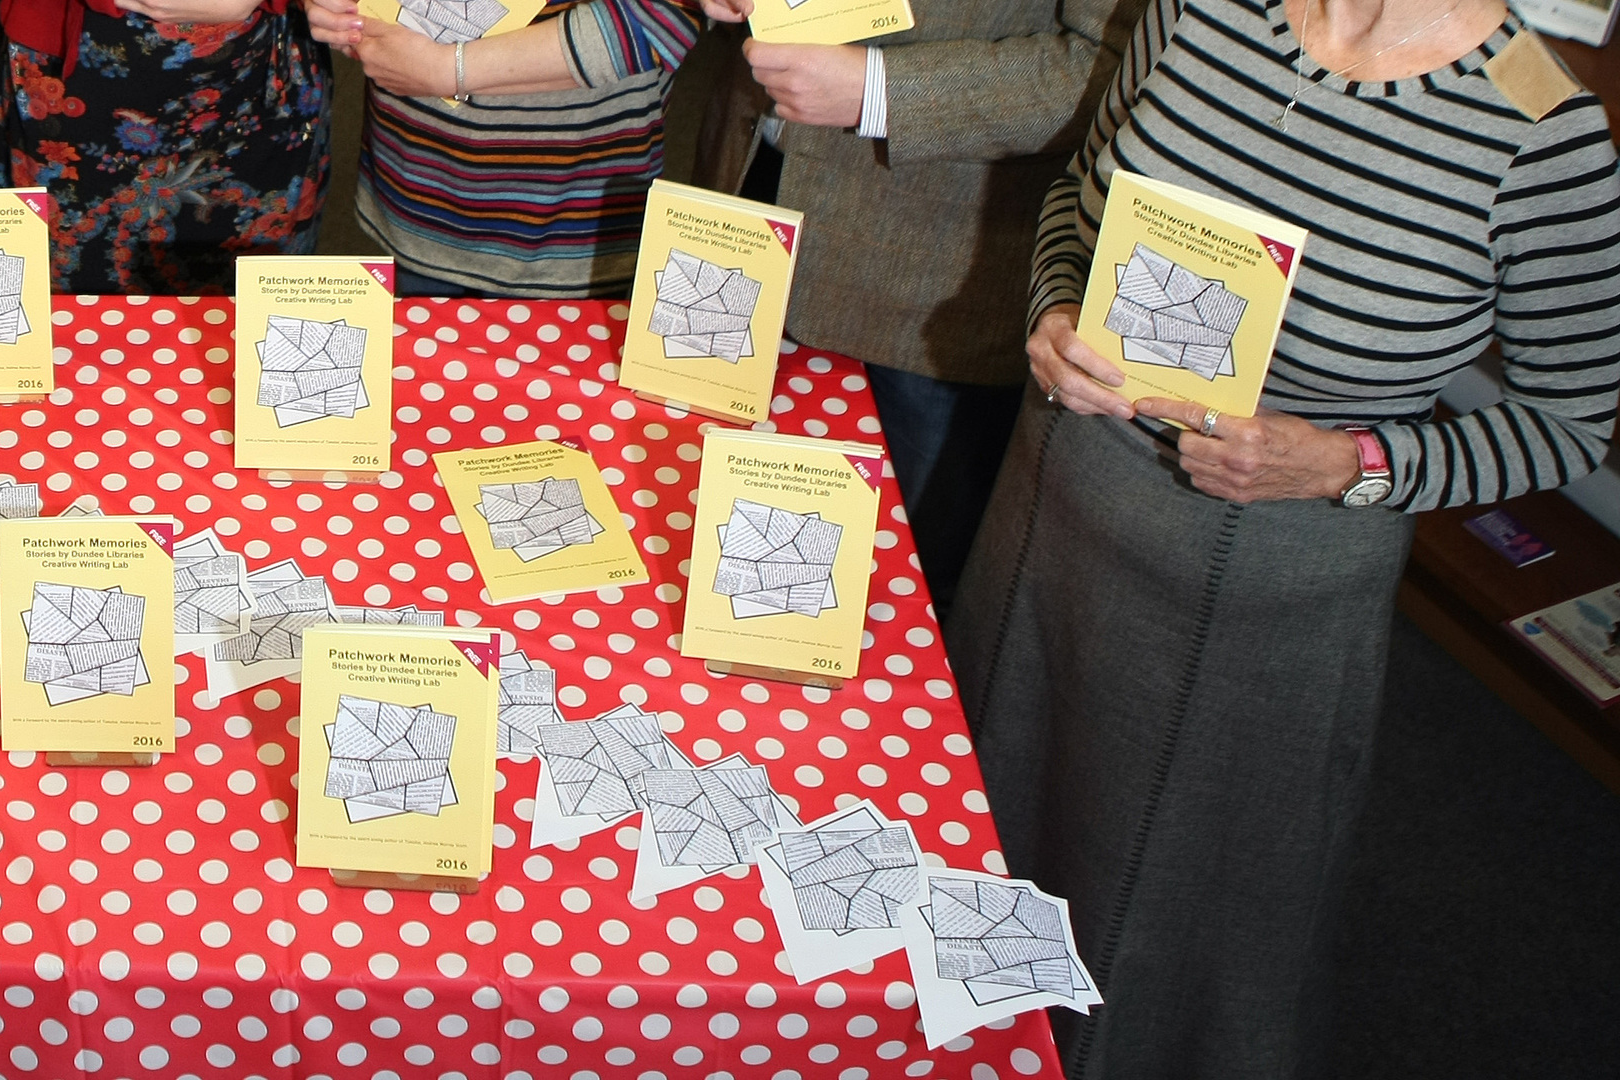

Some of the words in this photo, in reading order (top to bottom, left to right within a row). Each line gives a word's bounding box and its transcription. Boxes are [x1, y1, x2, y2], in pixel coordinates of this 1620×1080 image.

[870, 14, 898, 29] 2016
[25, 198, 41, 213] FREE
[666, 208, 719, 228] Patchwork
[721, 222, 771, 242] Memories
[1131, 198, 1198, 232] Patchwork
[1200, 227, 1262, 259] Memories
[667, 219, 693, 231] Stories
[694, 226, 703, 235] by
[705, 229, 733, 241] Dundee
[734, 236, 767, 250] Libraries
[1132, 210, 1165, 229] Stories
[1166, 225, 1177, 236] by
[1179, 230, 1214, 250] Dundee
[1216, 245, 1256, 267] Libraries
[678, 231, 709, 244] Creative
[710, 239, 736, 252] Writing
[738, 246, 752, 255] Lab
[1146, 226, 1184, 247] Creative
[1185, 243, 1218, 262] Writing
[1220, 257, 1237, 269] Lab
[258, 276, 314, 285] Patchwork
[318, 277, 369, 286] Memories
[371, 268, 387, 284] FREE
[17, 379, 42, 388] 2016
[730, 400, 755, 414] 2016
[352, 456, 378, 464] 2016
[457, 454, 512, 467] Patchwork
[514, 447, 563, 459] Memories
[727, 454, 790, 471] Patchwork
[793, 463, 851, 479] Memories
[854, 462, 871, 480] FREE
[729, 467, 759, 477] Stories
[761, 471, 772, 480] by
[774, 473, 807, 483] Dundee
[809, 477, 847, 489] Libraries
[743, 478, 778, 489] Creative
[781, 484, 812, 495] Writing
[814, 488, 830, 496] Lab
[22, 537, 85, 547] Patchwork
[89, 538, 147, 548] Memories
[148, 529, 166, 547] FREE
[59, 550, 68, 559] by
[71, 550, 103, 558] Dundee
[80, 561, 110, 569] Writing
[607, 567, 636, 578] 2016
[328, 648, 396, 662] Patchwork
[399, 653, 461, 667] Memories
[463, 647, 482, 666] FREE
[812, 658, 841, 669] 2016
[331, 662, 363, 671] Stories
[366, 664, 377, 673] by
[380, 665, 414, 674] Dundee
[417, 667, 457, 677] Libraries
[348, 673, 385, 682] Creative
[388, 676, 420, 686] Writing
[423, 678, 440, 686] Lab
[133, 736, 162, 745] 2016
[436, 859, 467, 869] 2016
